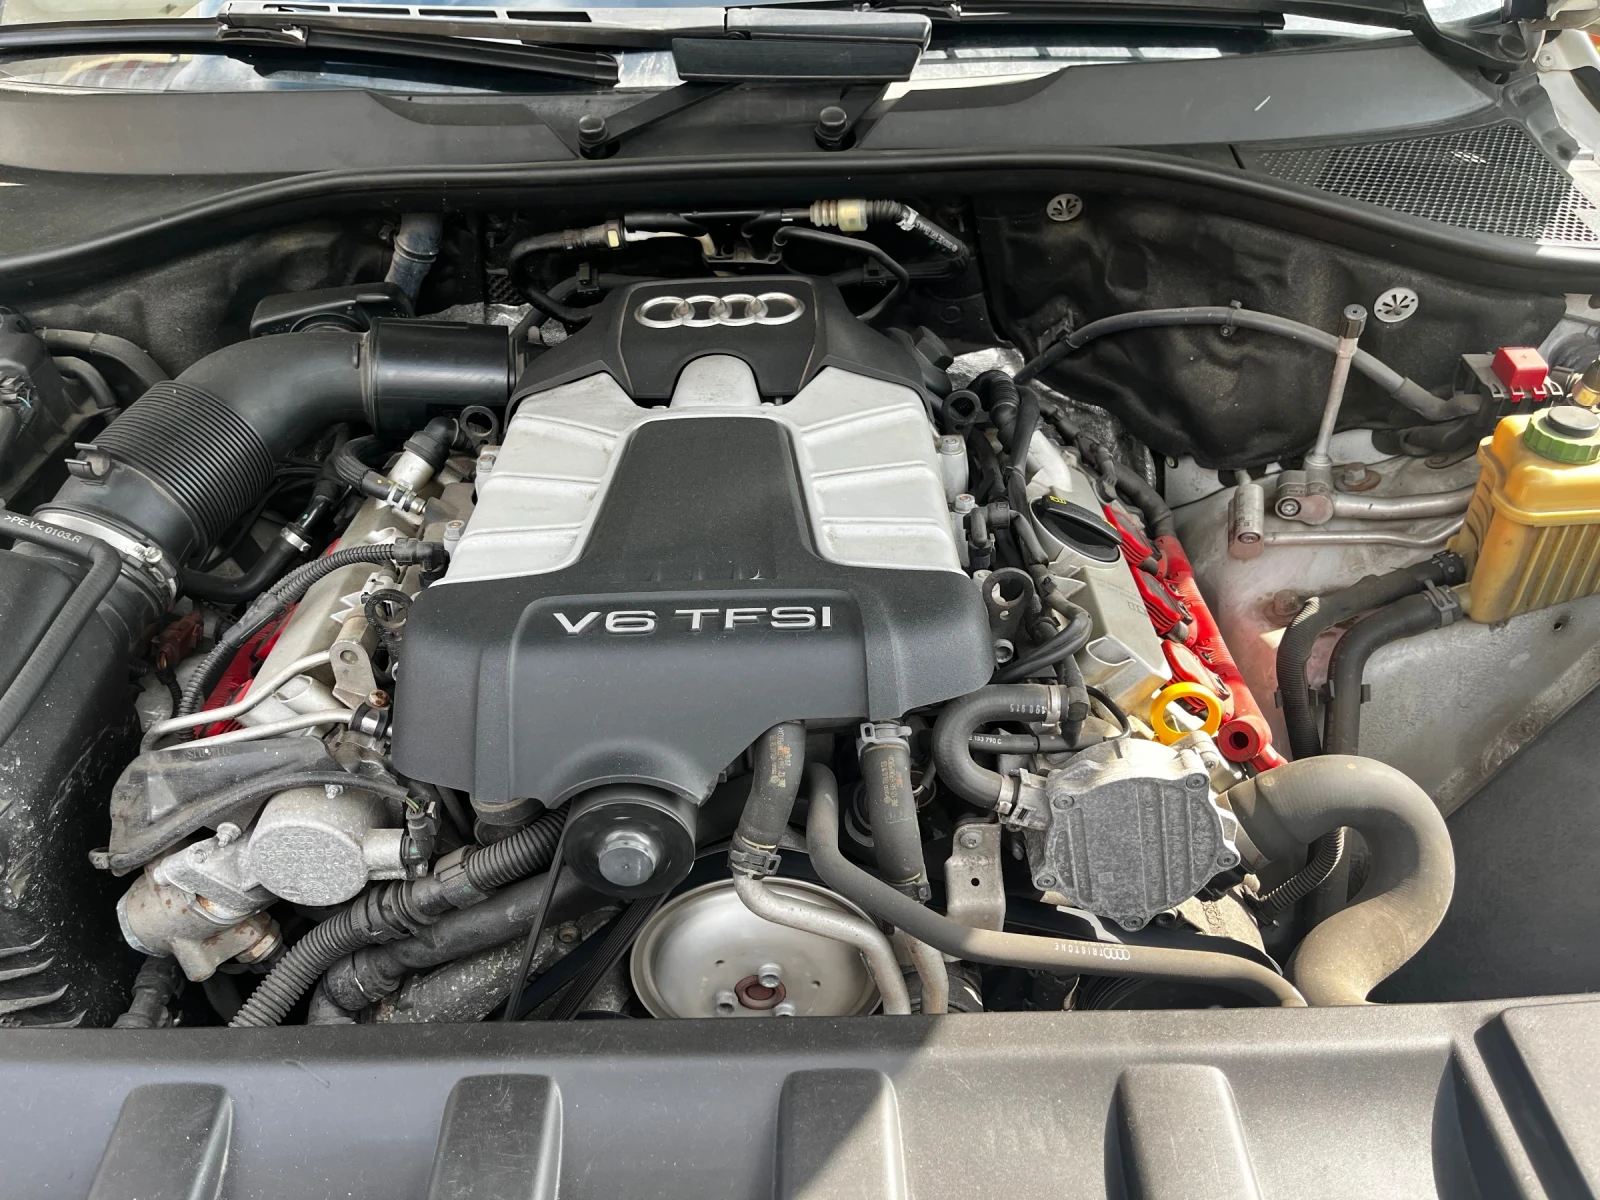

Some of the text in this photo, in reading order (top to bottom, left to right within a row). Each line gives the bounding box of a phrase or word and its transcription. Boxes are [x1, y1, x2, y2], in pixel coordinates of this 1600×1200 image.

[4, 514, 83, 544] >PE-V< 0103.R
[552, 605, 833, 636] V6 TFSI
[1054, 942, 1104, 956] TRISTONE
